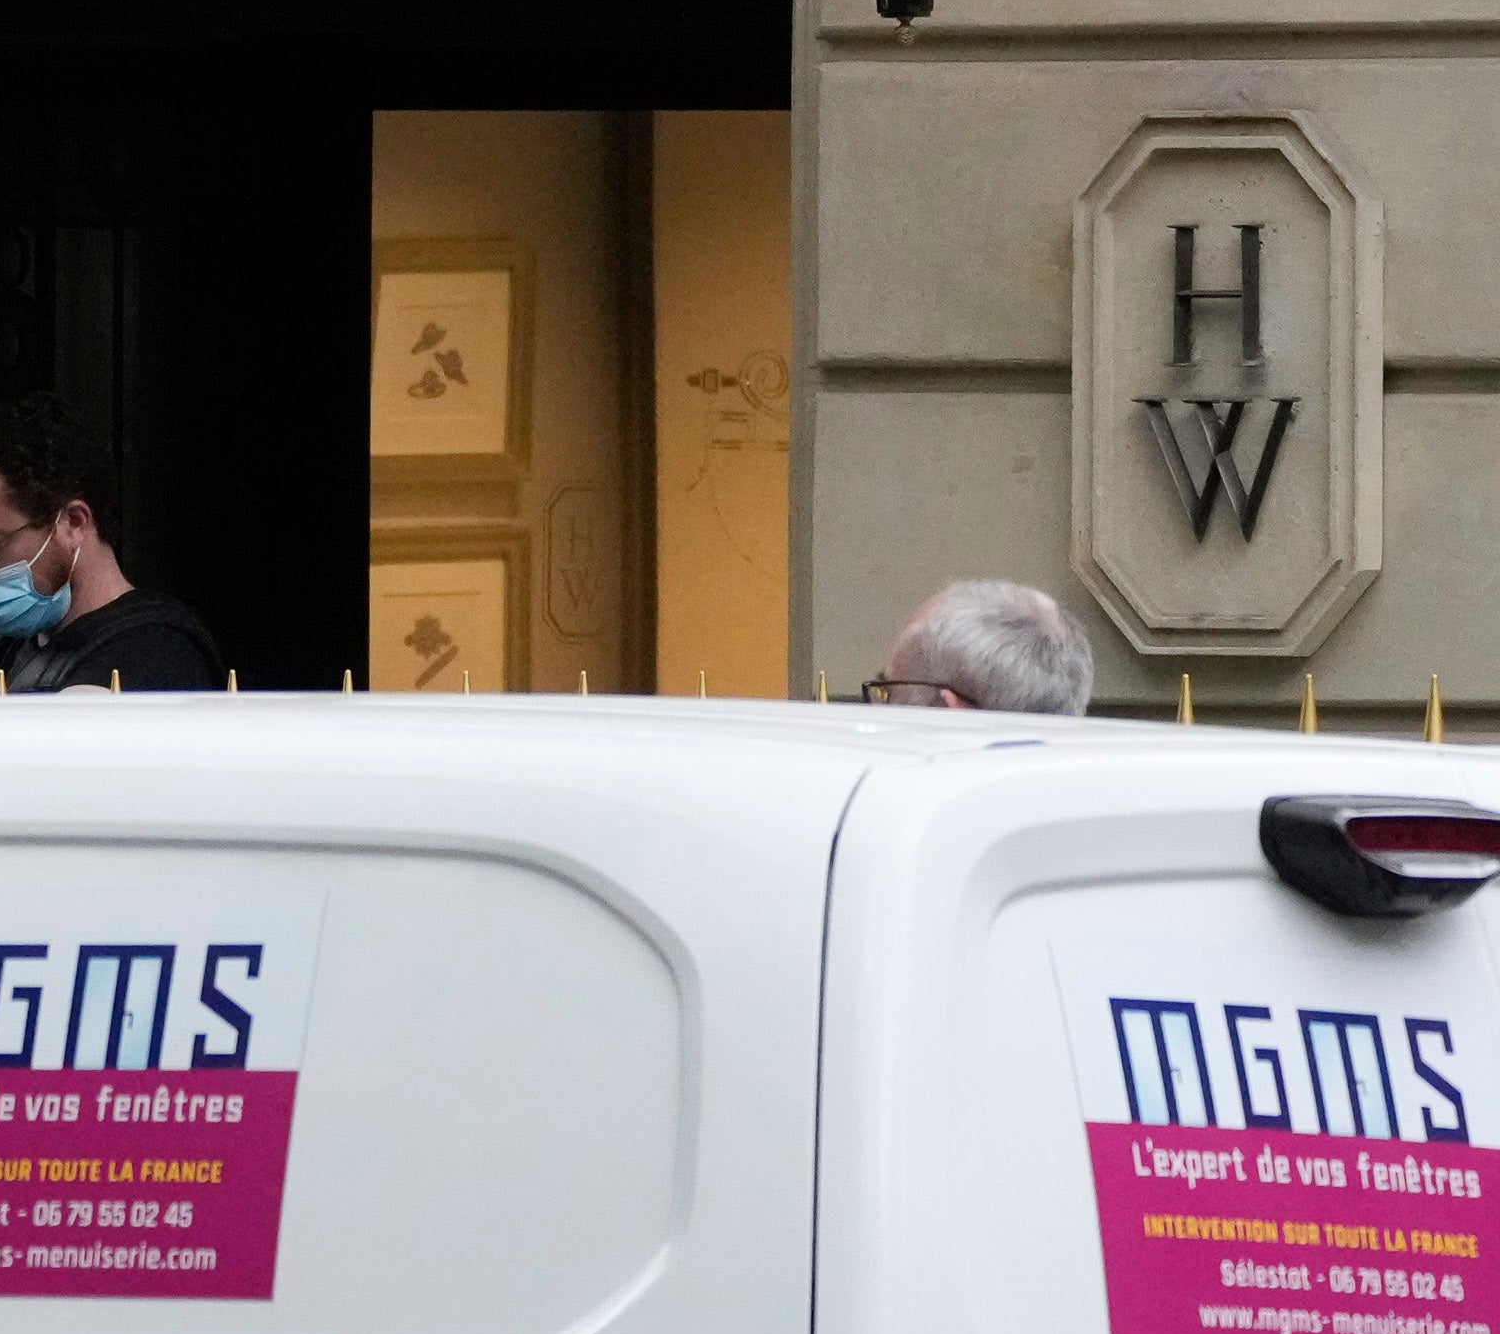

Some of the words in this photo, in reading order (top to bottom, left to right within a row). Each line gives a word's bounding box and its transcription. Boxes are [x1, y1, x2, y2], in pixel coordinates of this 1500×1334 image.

[1167, 224, 1266, 367] H
[1131, 397, 1300, 544] W
[24, 1094, 81, 1122] vos
[96, 1084, 244, 1123] fenêtres
[39, 1158, 102, 1182] TOUTE
[108, 1159, 134, 1183] LA
[140, 1159, 223, 1184] FRANCE
[1131, 1137, 1247, 1189] L'expert
[1257, 1143, 1292, 1184] de
[1296, 1156, 1348, 1188] vos
[1357, 1151, 1482, 1199] fenêtres
[33, 1199, 62, 1227] 06
[67, 1199, 93, 1227] 79
[97, 1199, 126, 1228] 55
[130, 1200, 160, 1228] 02
[164, 1200, 194, 1228] 45
[1143, 1213, 1279, 1243] INTERVENTION
[1323, 1223, 1380, 1251] TOUTE
[1384, 1227, 1408, 1252] LA
[1411, 1229, 1480, 1258] FRANCE
[1329, 1265, 1356, 1294] 06
[1411, 1270, 1437, 1300] 02
[1440, 1274, 1465, 1302] 45
